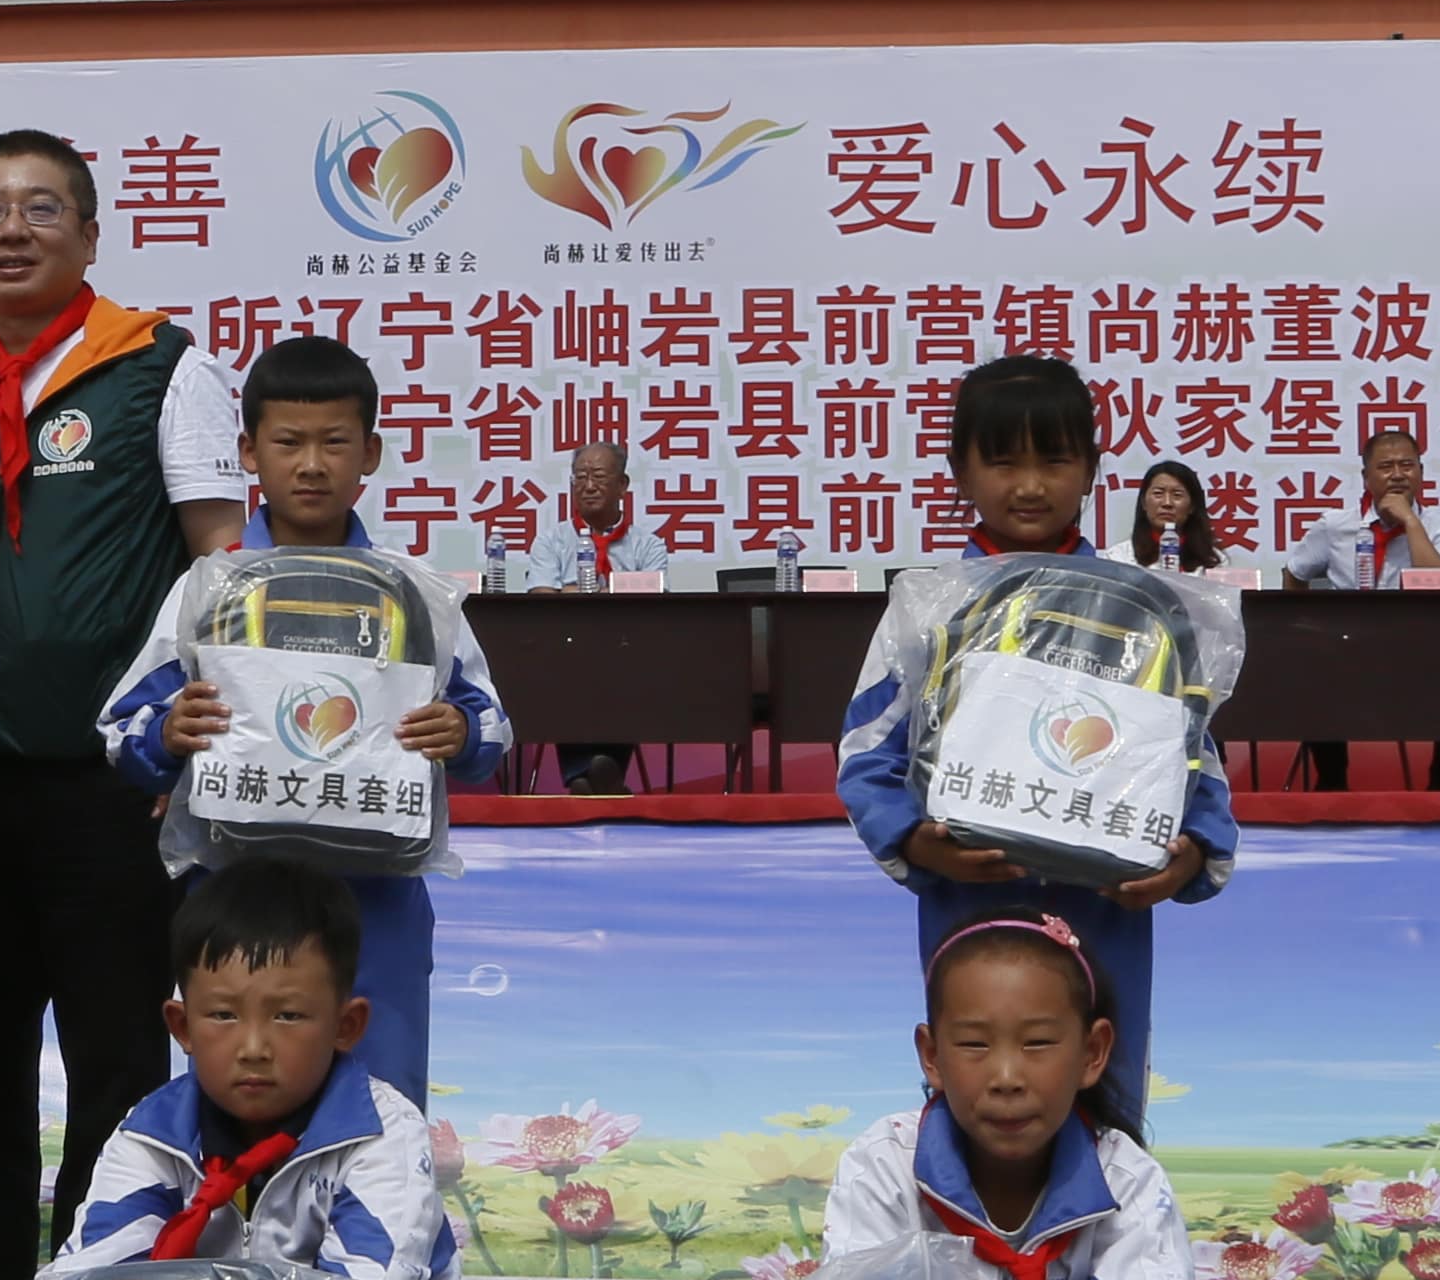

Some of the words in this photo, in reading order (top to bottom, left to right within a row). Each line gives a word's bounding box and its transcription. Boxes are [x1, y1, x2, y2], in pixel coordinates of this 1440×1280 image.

[826, 114, 1327, 238] 爱心永续
[407, 213, 434, 237] SUN
[306, 251, 479, 278] 尚赫公益基金会
[197, 761, 426, 818] 尚赫文具套组
[938, 761, 1178, 849] 尚赫文具套组
